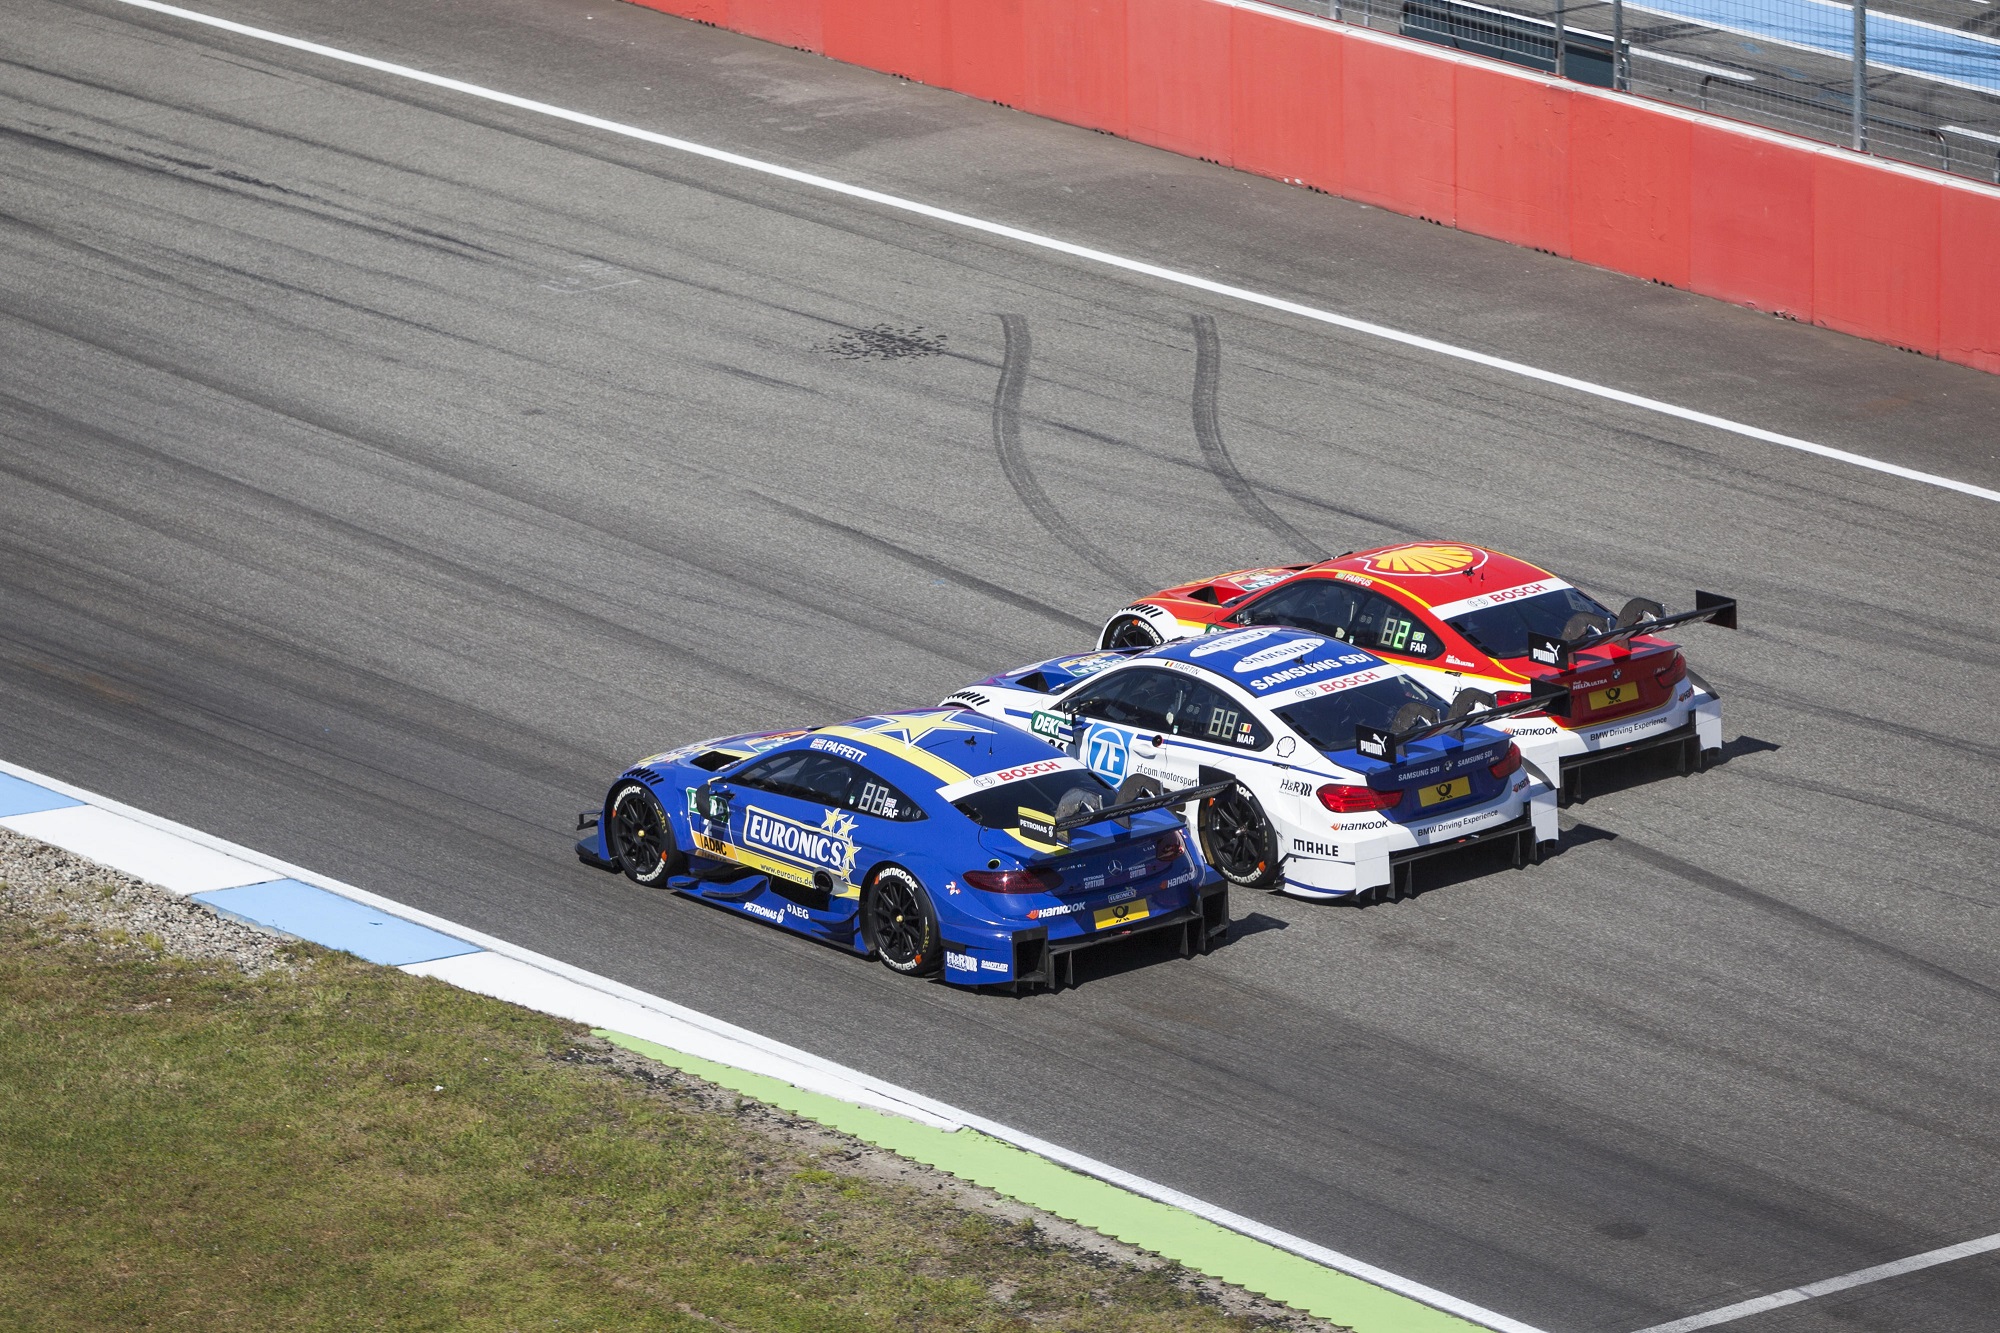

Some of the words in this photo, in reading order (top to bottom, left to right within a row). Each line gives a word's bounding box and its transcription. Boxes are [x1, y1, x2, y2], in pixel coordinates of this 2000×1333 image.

[1344, 574, 1373, 587] FARFUS
[1489, 584, 1548, 603] BOSCH
[1240, 642, 1320, 665] SAMSUNG
[1410, 642, 1427, 653] FAR
[1533, 648, 1556, 664] PUMA
[1173, 662, 1201, 676] MARTIN
[1250, 656, 1343, 690] SAMSUNG
[1343, 653, 1374, 665] SDI
[1318, 671, 1381, 693] BOSCH
[1034, 713, 1060, 736] DEK
[1590, 731, 1609, 741] BMW
[1609, 726, 1633, 738] Driving
[1633, 716, 1668, 731] Experience
[1236, 733, 1255, 746] MAR
[1360, 739, 1382, 756] PUMA
[823, 740, 868, 763] PAFFETT
[1457, 753, 1484, 767] SAMSUNG
[1484, 750, 1493, 759] SDI
[996, 761, 1062, 782] BOSCH
[1398, 767, 1429, 781] SAMSUNG
[1429, 766, 1440, 775] SDI
[882, 806, 900, 819] PAF
[1019, 818, 1048, 834] PETRONAS
[1417, 826, 1437, 837] BMW
[1438, 820, 1463, 833] Driving
[1463, 810, 1498, 827] Experience
[704, 837, 727, 856] ADAC
[750, 814, 842, 867] EURONICS
[1294, 838, 1339, 857] MAHLE
[760, 864, 813, 886] www.euronics.de
[743, 901, 777, 920] PETRONAS
[791, 905, 809, 920] AEG
